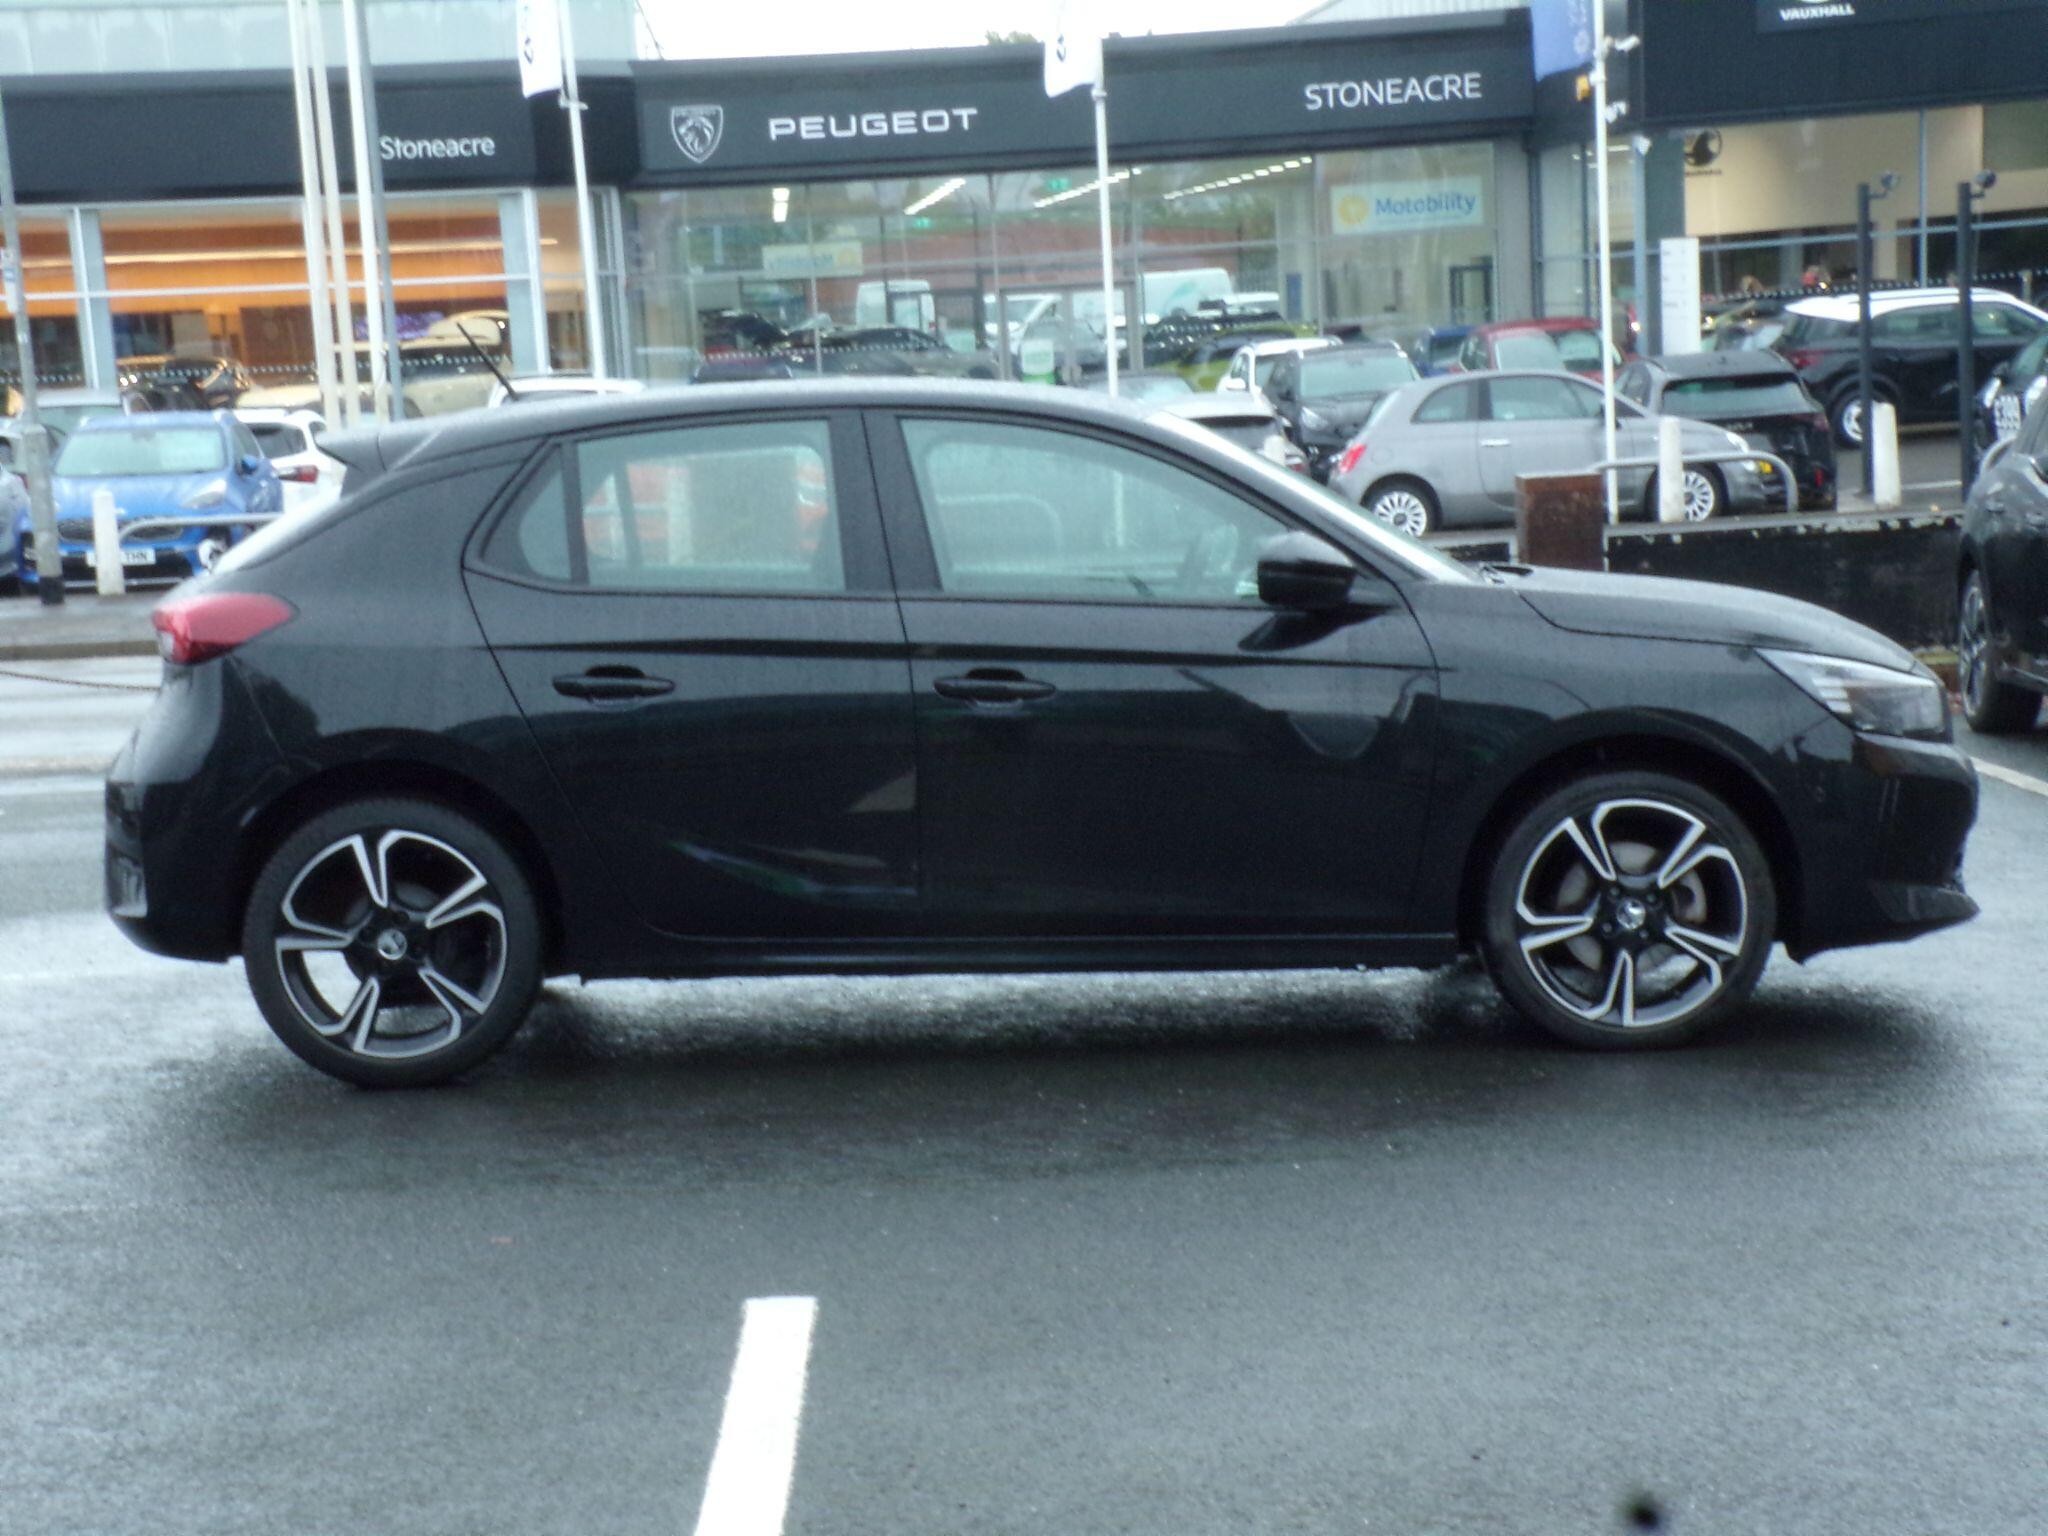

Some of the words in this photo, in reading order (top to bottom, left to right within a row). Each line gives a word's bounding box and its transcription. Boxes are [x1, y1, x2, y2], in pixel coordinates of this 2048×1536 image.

[1780, 3, 1855, 21] VAUXHALL
[1304, 72, 1482, 111] STONEACRE
[768, 107, 978, 141] PEUGEOT
[380, 135, 495, 160] Stoneacre
